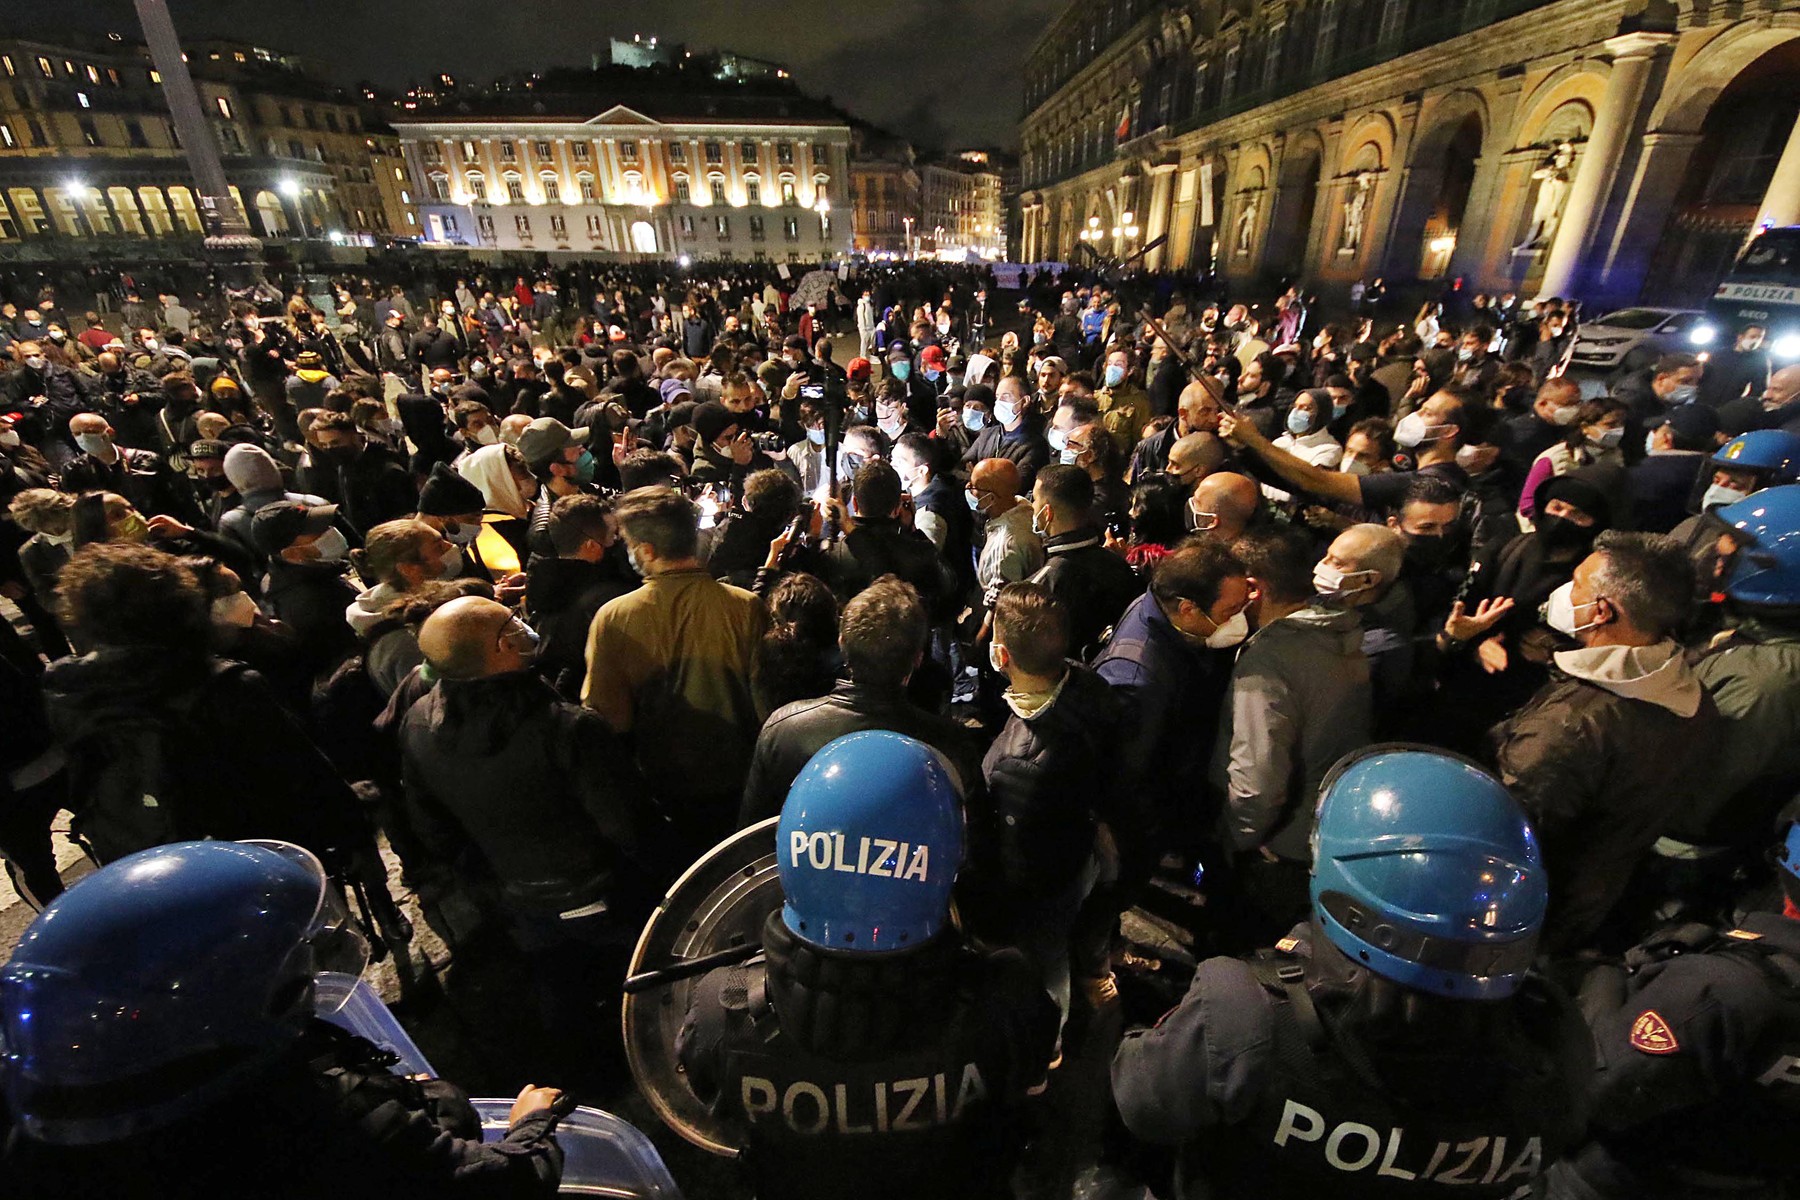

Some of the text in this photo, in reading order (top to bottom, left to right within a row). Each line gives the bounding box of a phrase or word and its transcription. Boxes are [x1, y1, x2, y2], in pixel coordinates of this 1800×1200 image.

[1734, 287, 1795, 299] POLIZIA
[790, 831, 929, 882] POLIZIA
[741, 1062, 988, 1134] POLIZIA
[1273, 1099, 1542, 1184] POLIZIA
